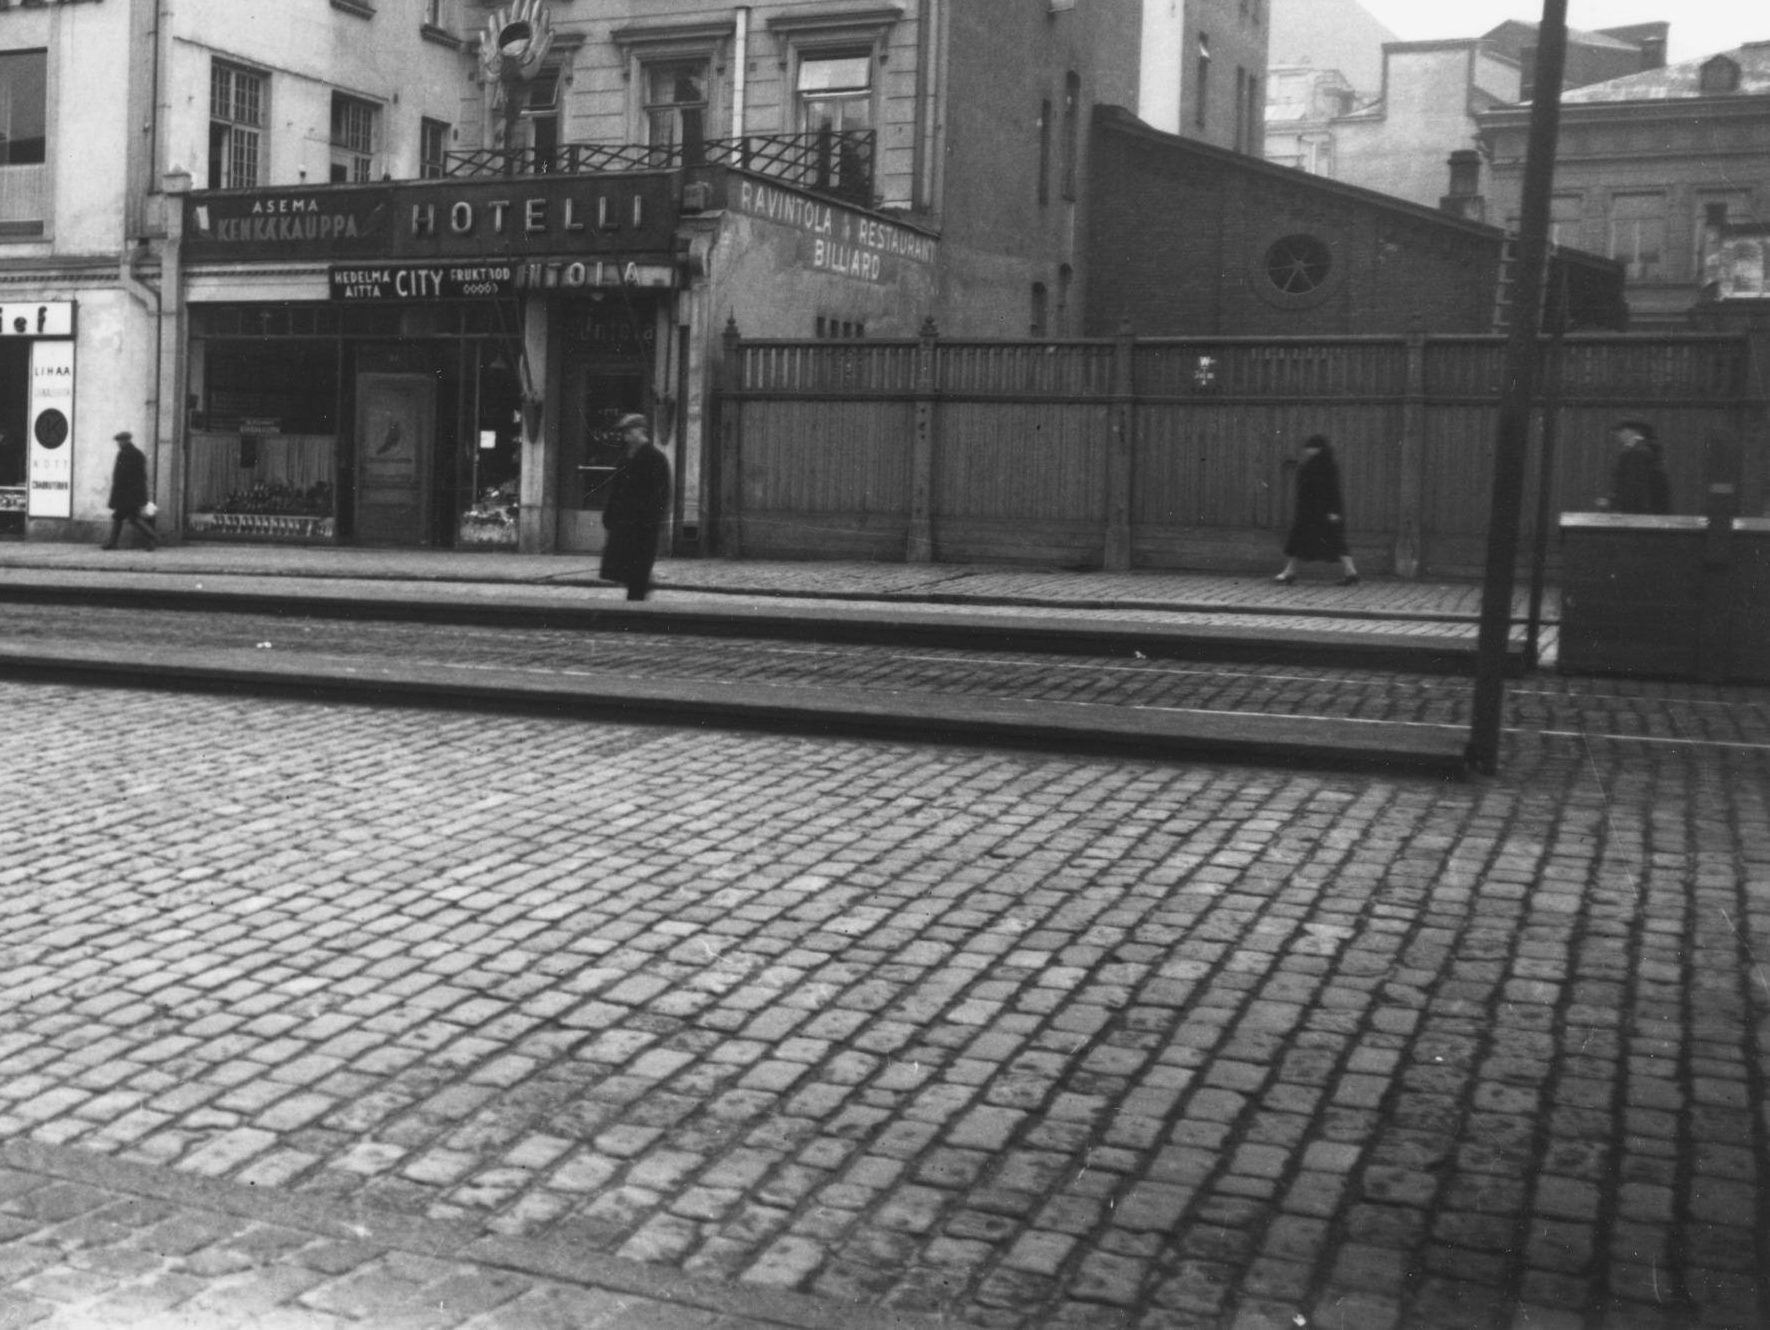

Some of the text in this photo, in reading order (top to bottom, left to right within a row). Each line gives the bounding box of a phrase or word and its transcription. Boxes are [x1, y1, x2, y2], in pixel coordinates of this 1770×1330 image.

[252, 199, 318, 213] ASEMA
[412, 195, 642, 234] HOTELLI
[741, 181, 936, 263] RAVINTOLA RESTAURANT
[814, 239, 880, 280] BILLIARD
[345, 285, 381, 297] AITTA
[396, 269, 443, 297] CITY
[35, 367, 70, 377] LIHAA
